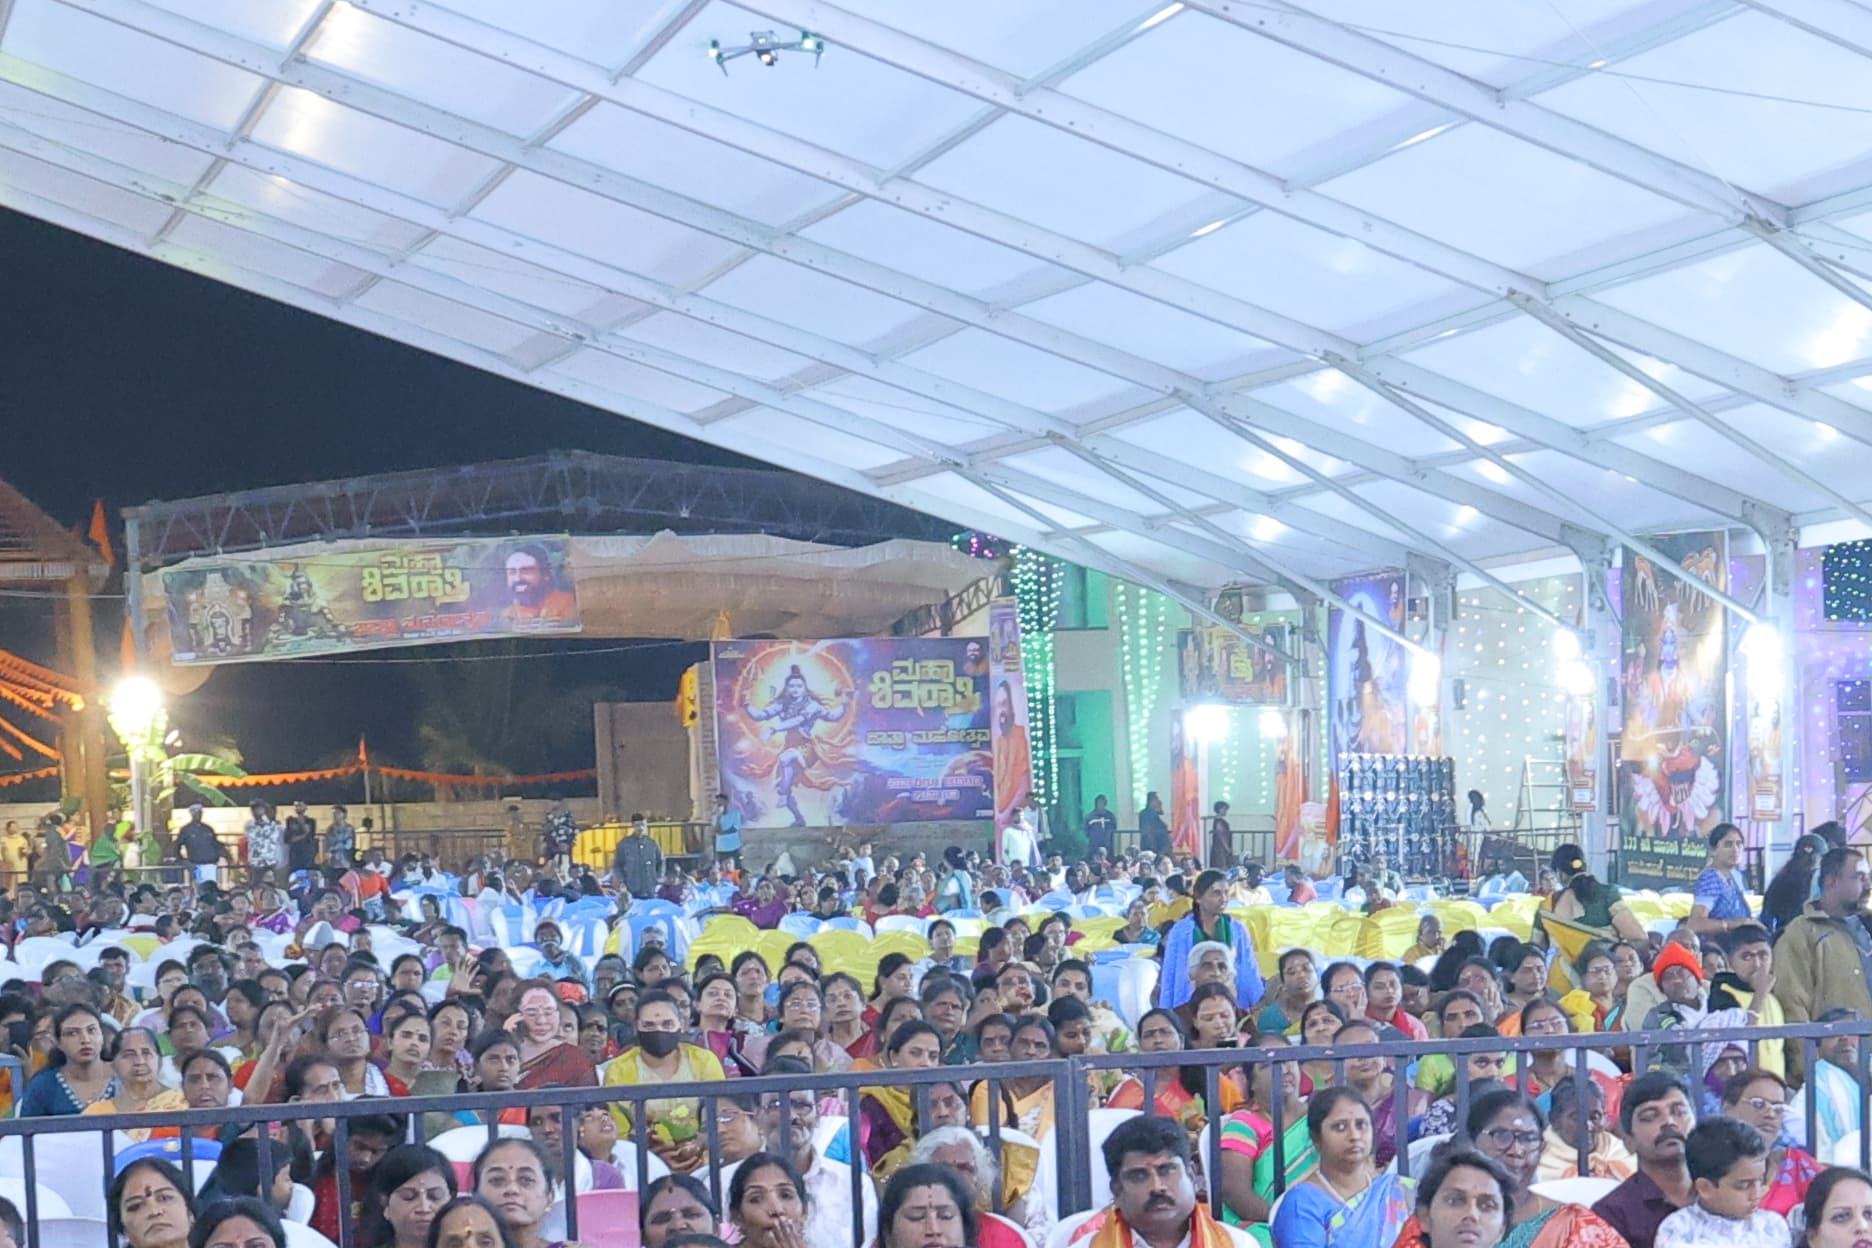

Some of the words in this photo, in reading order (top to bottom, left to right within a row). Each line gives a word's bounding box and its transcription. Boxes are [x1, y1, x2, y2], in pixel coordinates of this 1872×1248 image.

[362, 567, 471, 606] ಶಿವರಾತ್ರಿ
[892, 657, 955, 682] ಮಹಾ
[870, 672, 981, 716] ಶಿವರಾತ್ರಿ
